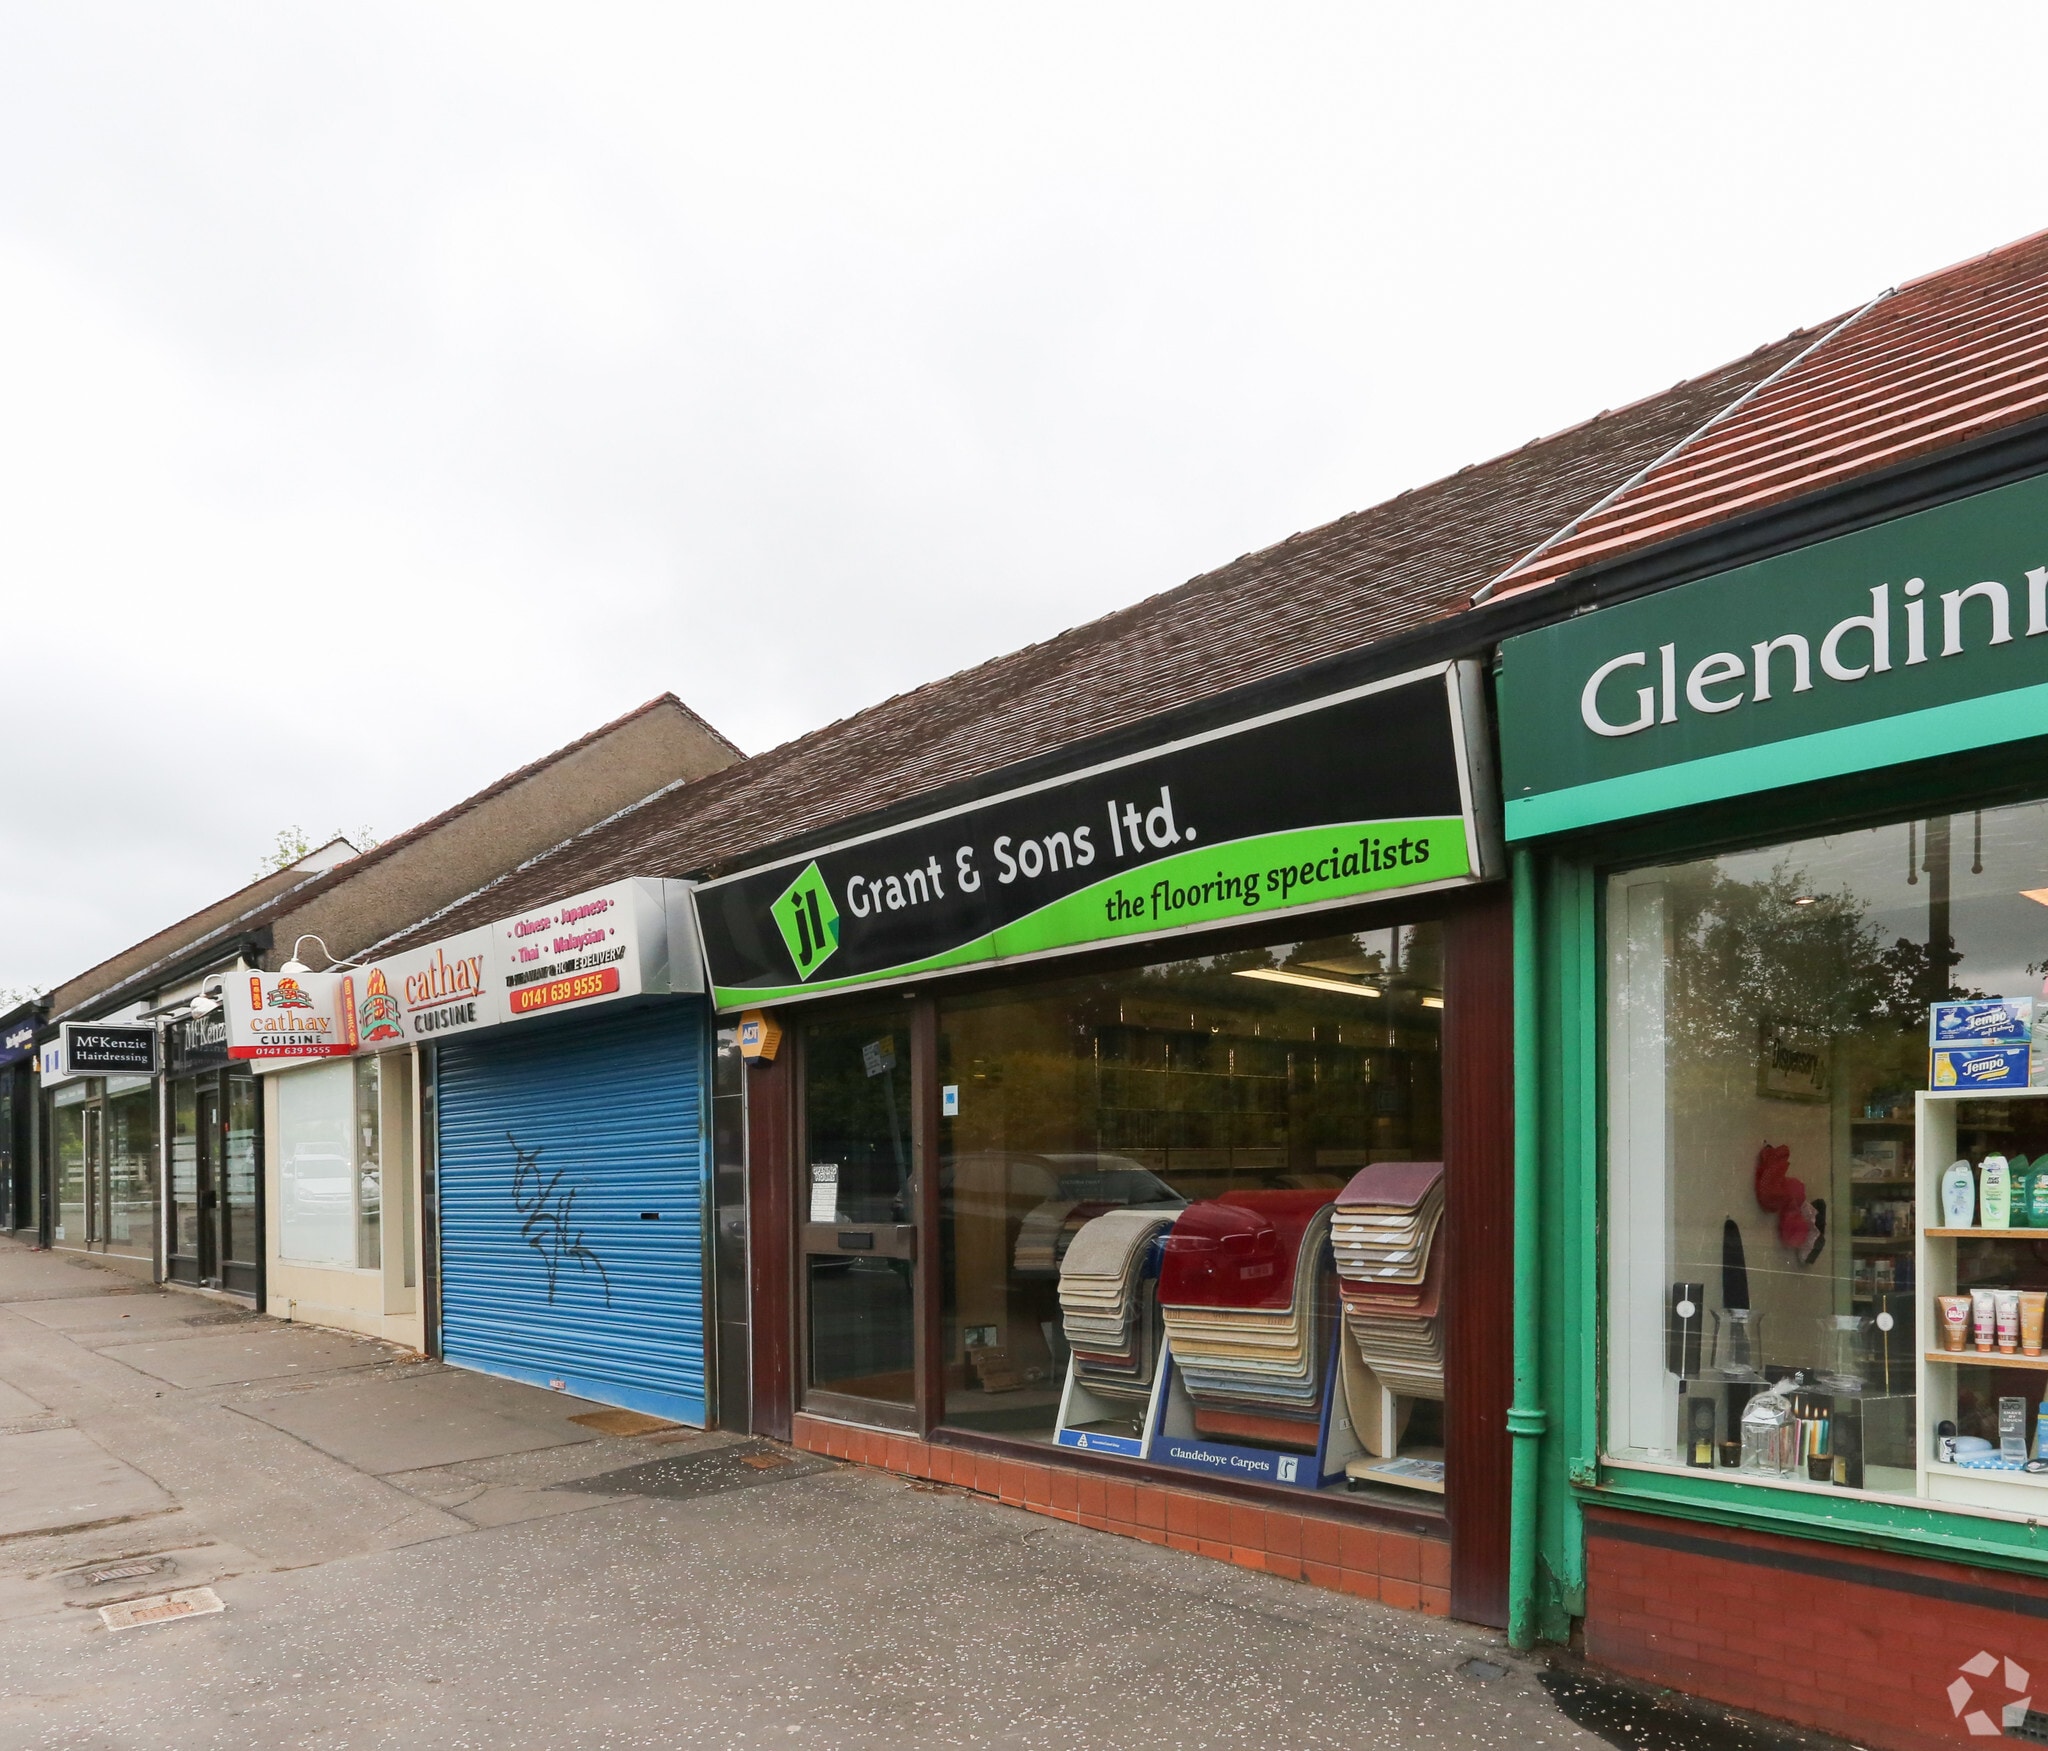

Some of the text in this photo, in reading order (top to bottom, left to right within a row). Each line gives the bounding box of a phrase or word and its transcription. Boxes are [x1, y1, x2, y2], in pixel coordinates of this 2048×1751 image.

[846, 785, 1197, 918] Grant & Sons ltd.
[1105, 837, 1430, 921] the flooring specialists
[514, 899, 608, 938] Chinese Japanese
[518, 928, 605, 963] Thai Malaysian
[581, 945, 626, 968] DELIVERY
[404, 947, 484, 1005] cathay
[521, 974, 603, 1008] 0141 639 9555
[250, 1010, 331, 1034] cathay
[414, 1002, 477, 1033] CUISINE
[1965, 1008, 2007, 1030] Tempo
[76, 1036, 147, 1049] McKenzie
[261, 1035, 322, 1044] CUISINE
[742, 1025, 759, 1040] ADT
[76, 1051, 148, 1063] Hairdressing
[306, 1046, 331, 1054] 9555
[1962, 1055, 2004, 1076] Tempo
[1170, 1447, 1270, 1471] Clandeboye Carpets
